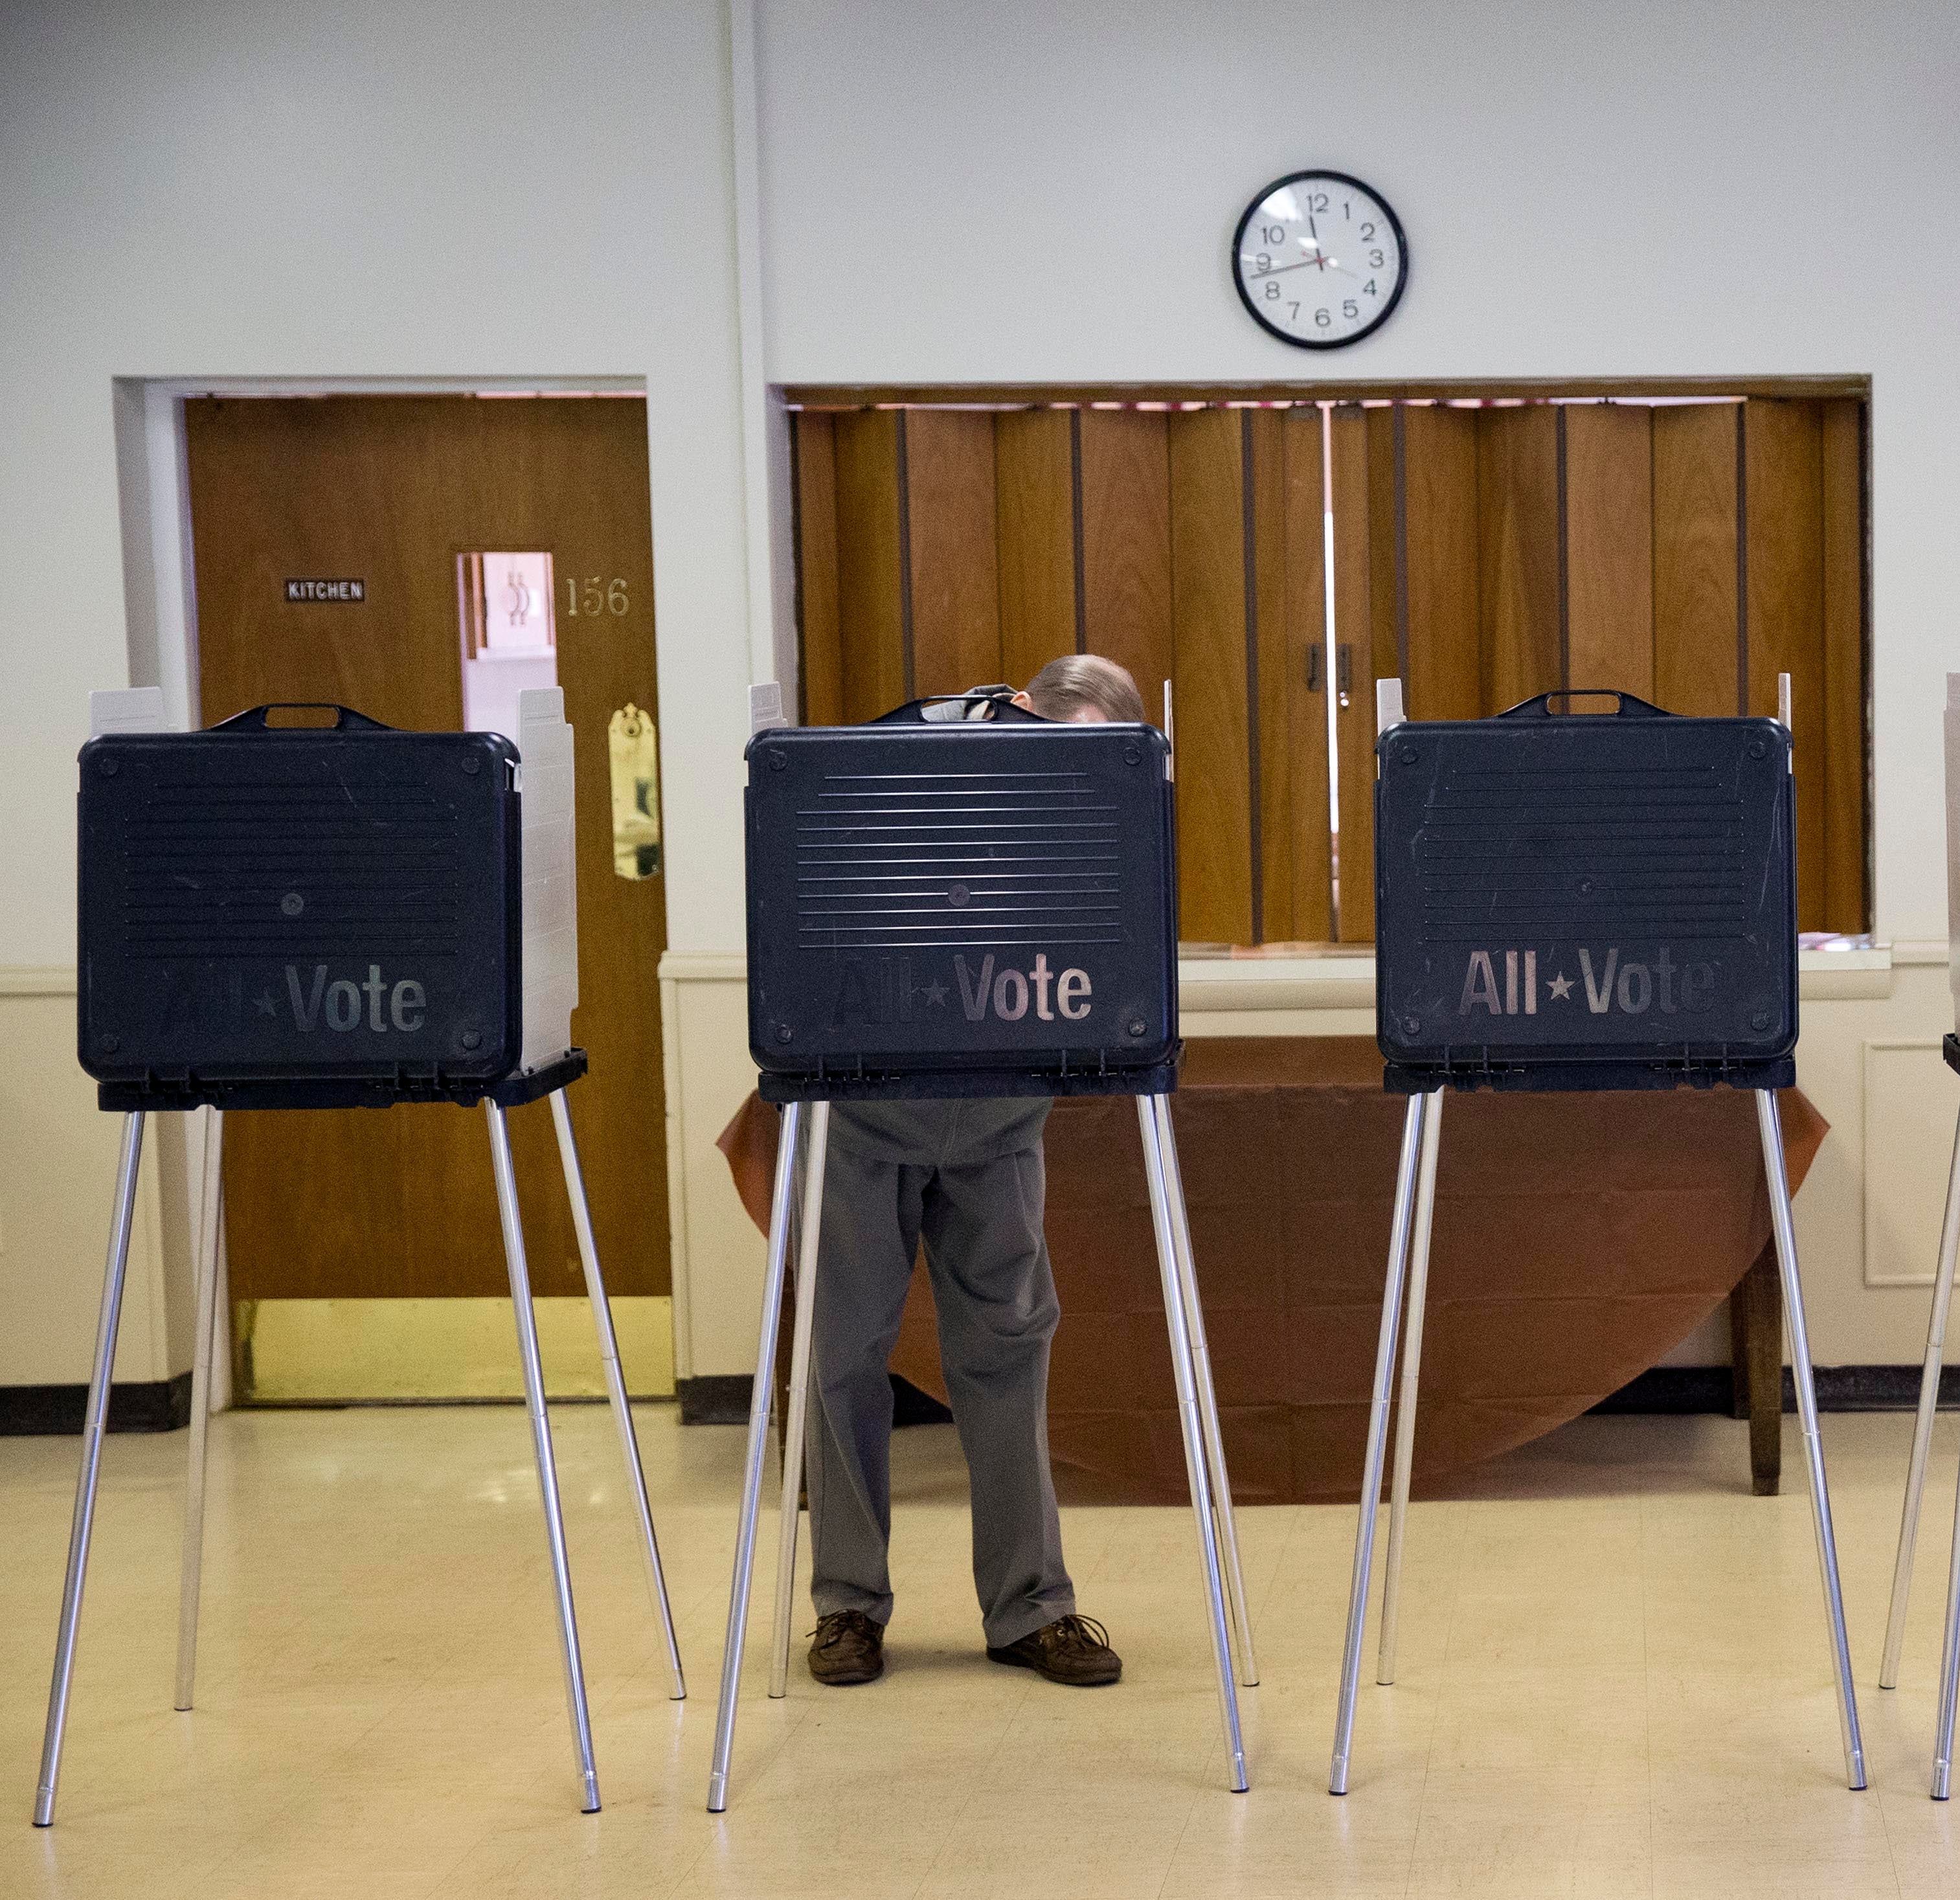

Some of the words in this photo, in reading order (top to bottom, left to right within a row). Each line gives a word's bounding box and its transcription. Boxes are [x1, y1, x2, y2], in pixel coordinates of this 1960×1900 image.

[1307, 194, 1329, 212] 12
[1343, 201, 1349, 220] 1
[1263, 225, 1285, 245] 10
[1360, 222, 1375, 242] 2
[1256, 253, 1271, 271] 9
[1369, 249, 1384, 268] 3
[1265, 281, 1280, 300] 8
[1364, 278, 1377, 296] 4
[1287, 301, 1300, 319] 7
[1315, 308, 1330, 326] 6
[1343, 299, 1358, 318] 5
[288, 582, 363, 600] KITCHEN
[566, 576, 629, 616] 156
[954, 953, 1092, 1021] Vote
[1458, 951, 1537, 1015] All
[1578, 947, 1715, 1013] Vote
[285, 964, 427, 1033] Vote
